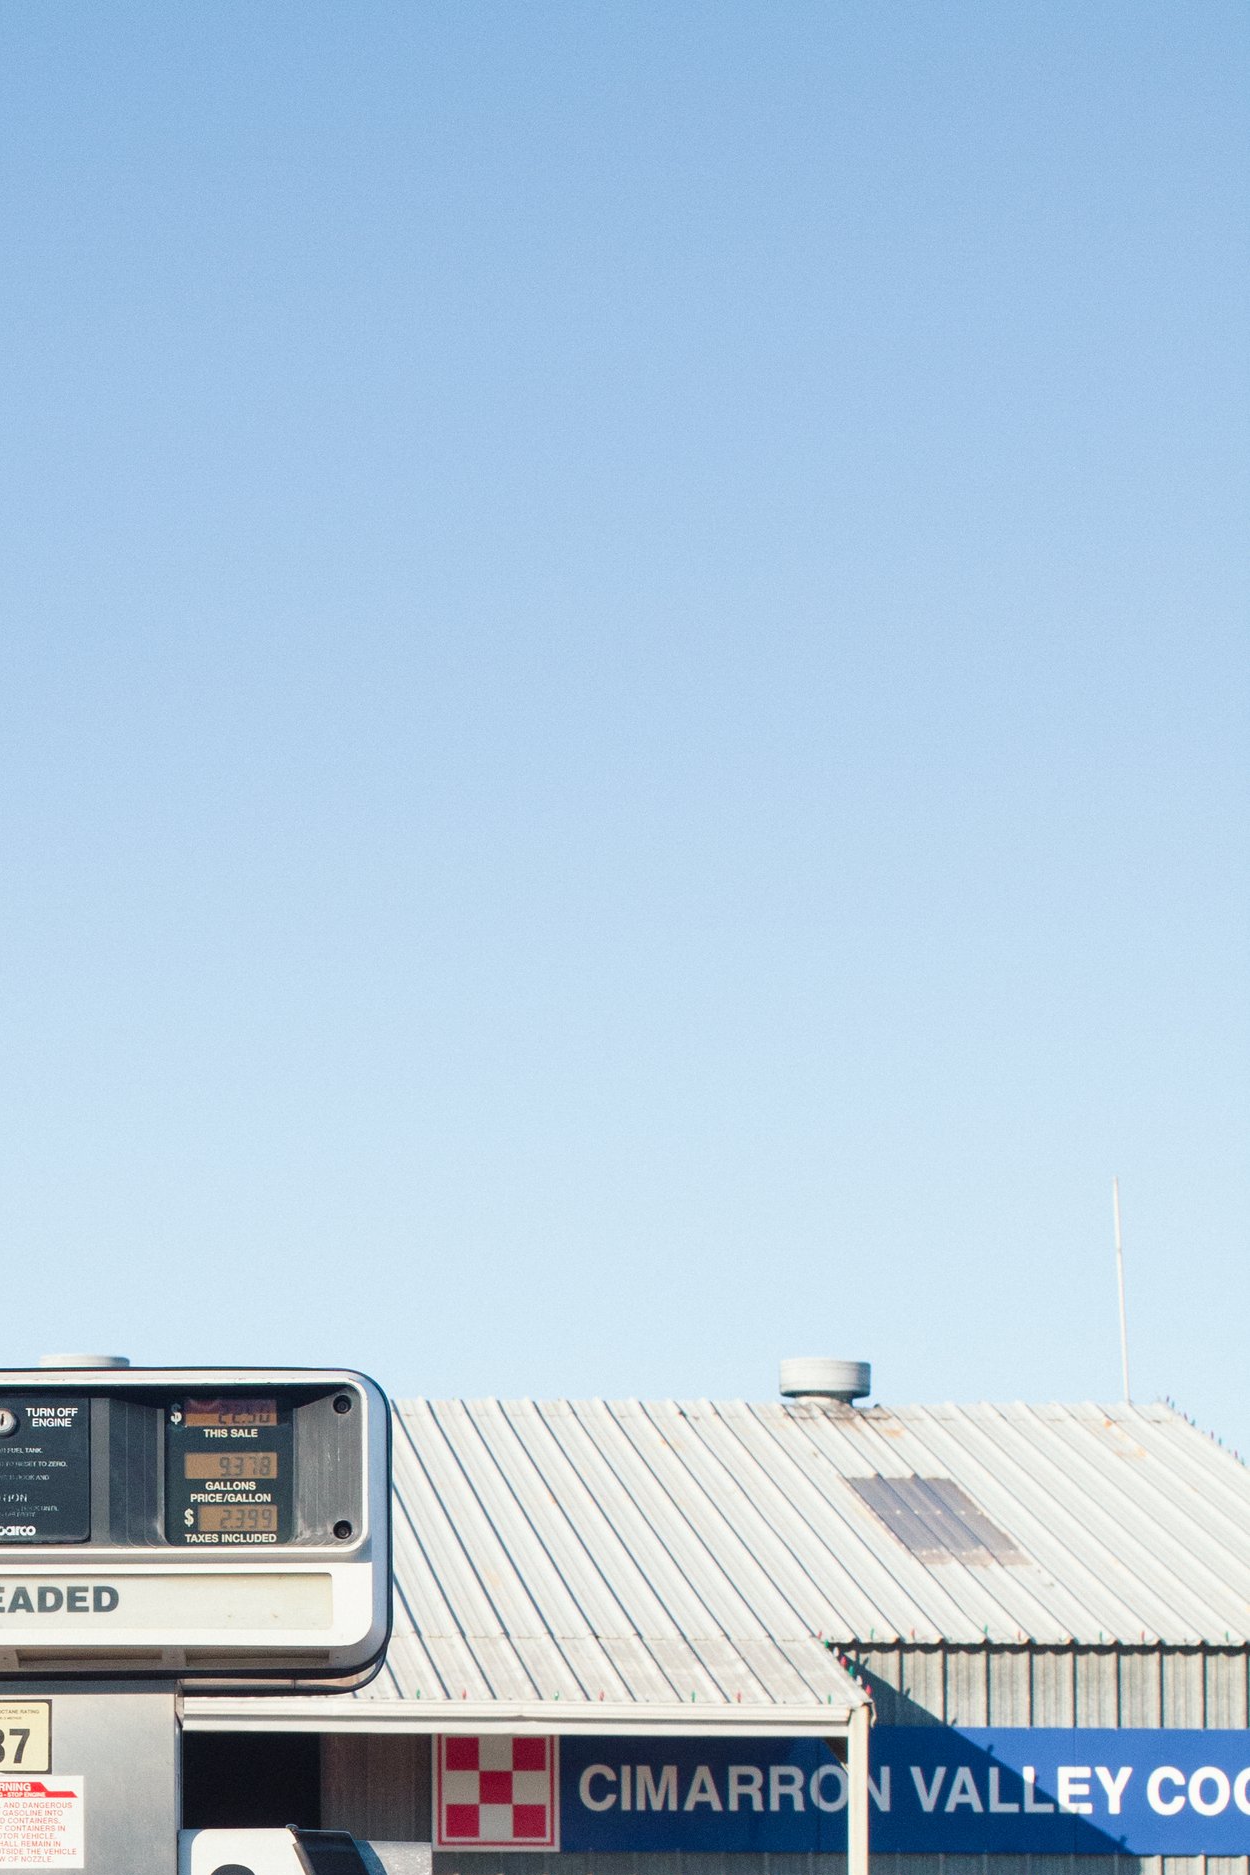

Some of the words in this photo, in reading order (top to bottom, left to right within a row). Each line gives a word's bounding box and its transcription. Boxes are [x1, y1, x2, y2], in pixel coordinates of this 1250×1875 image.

[25, 1408, 55, 1417] TURN
[57, 1408, 78, 1417] OFF
[32, 1418, 72, 1427] ENGINE
[203, 1429, 228, 1438] THIS
[230, 1429, 258, 1438] SALE
[205, 1481, 256, 1490] GALLONS
[190, 1493, 271, 1503] PRICE/GALLON
[184, 1508, 194, 1527] $
[185, 1534, 219, 1543] TAXES
[221, 1534, 277, 1543] INCLUDED
[579, 1764, 890, 1812] CIMARRON
[910, 1766, 1133, 1815] VALLEY
